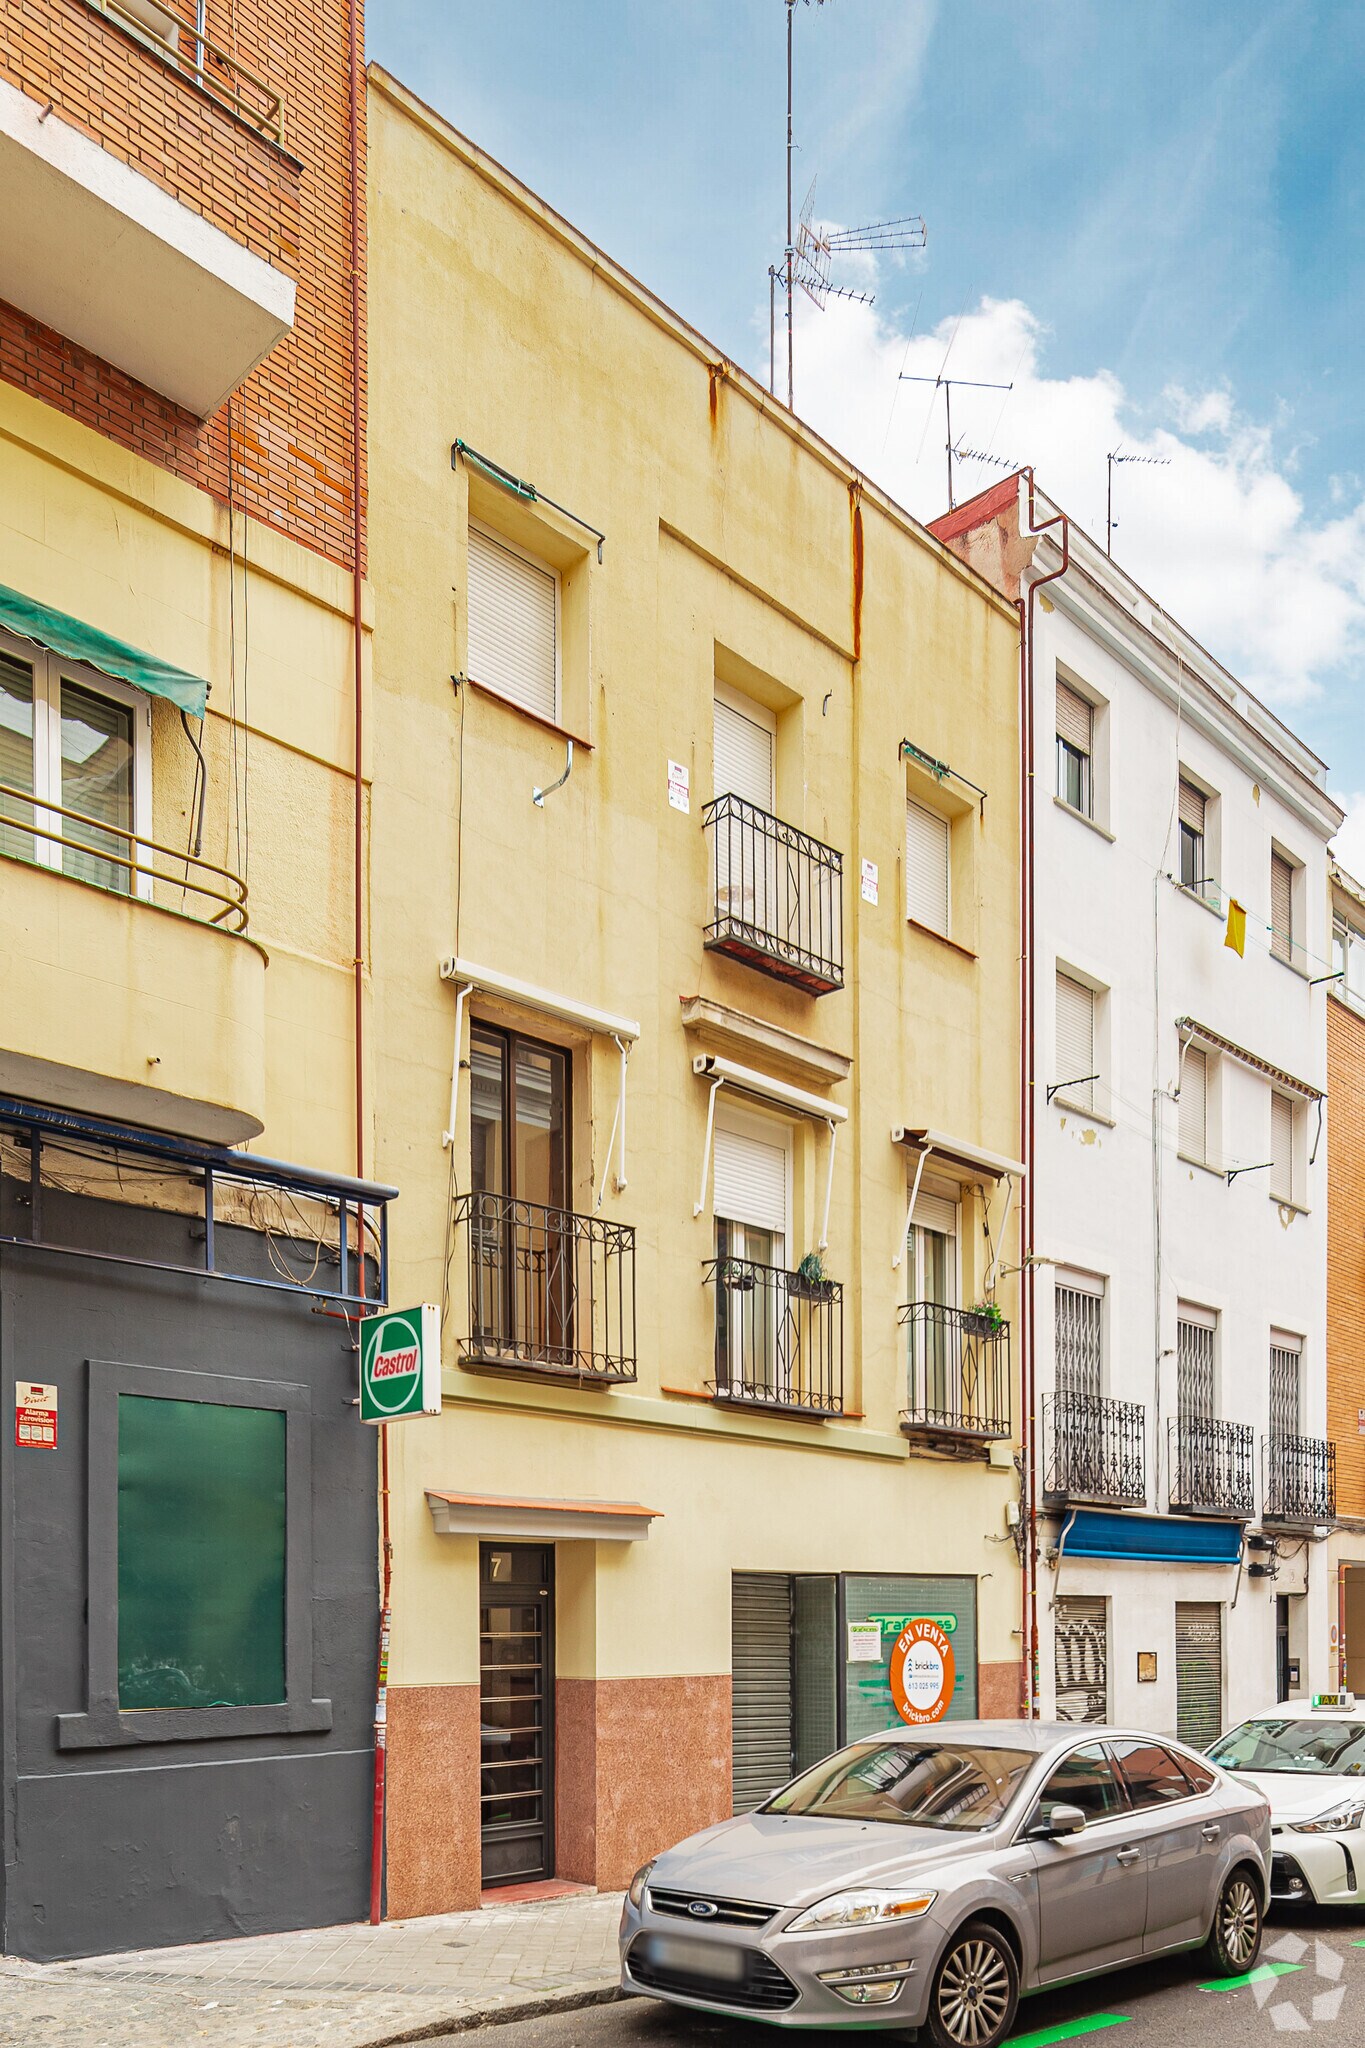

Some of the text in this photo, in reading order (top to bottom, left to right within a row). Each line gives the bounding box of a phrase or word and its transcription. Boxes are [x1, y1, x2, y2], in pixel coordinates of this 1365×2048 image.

[373, 1349, 418, 1378] Castrol
[19, 1414, 55, 1423] Zerovision
[25, 1408, 49, 1417] Alarma
[491, 1557, 502, 1577] 7
[898, 1628, 915, 1654] EN
[915, 1623, 949, 1657] VENTA
[914, 1660, 939, 1670] brickbro
[902, 1700, 944, 1724] brickbro.com
